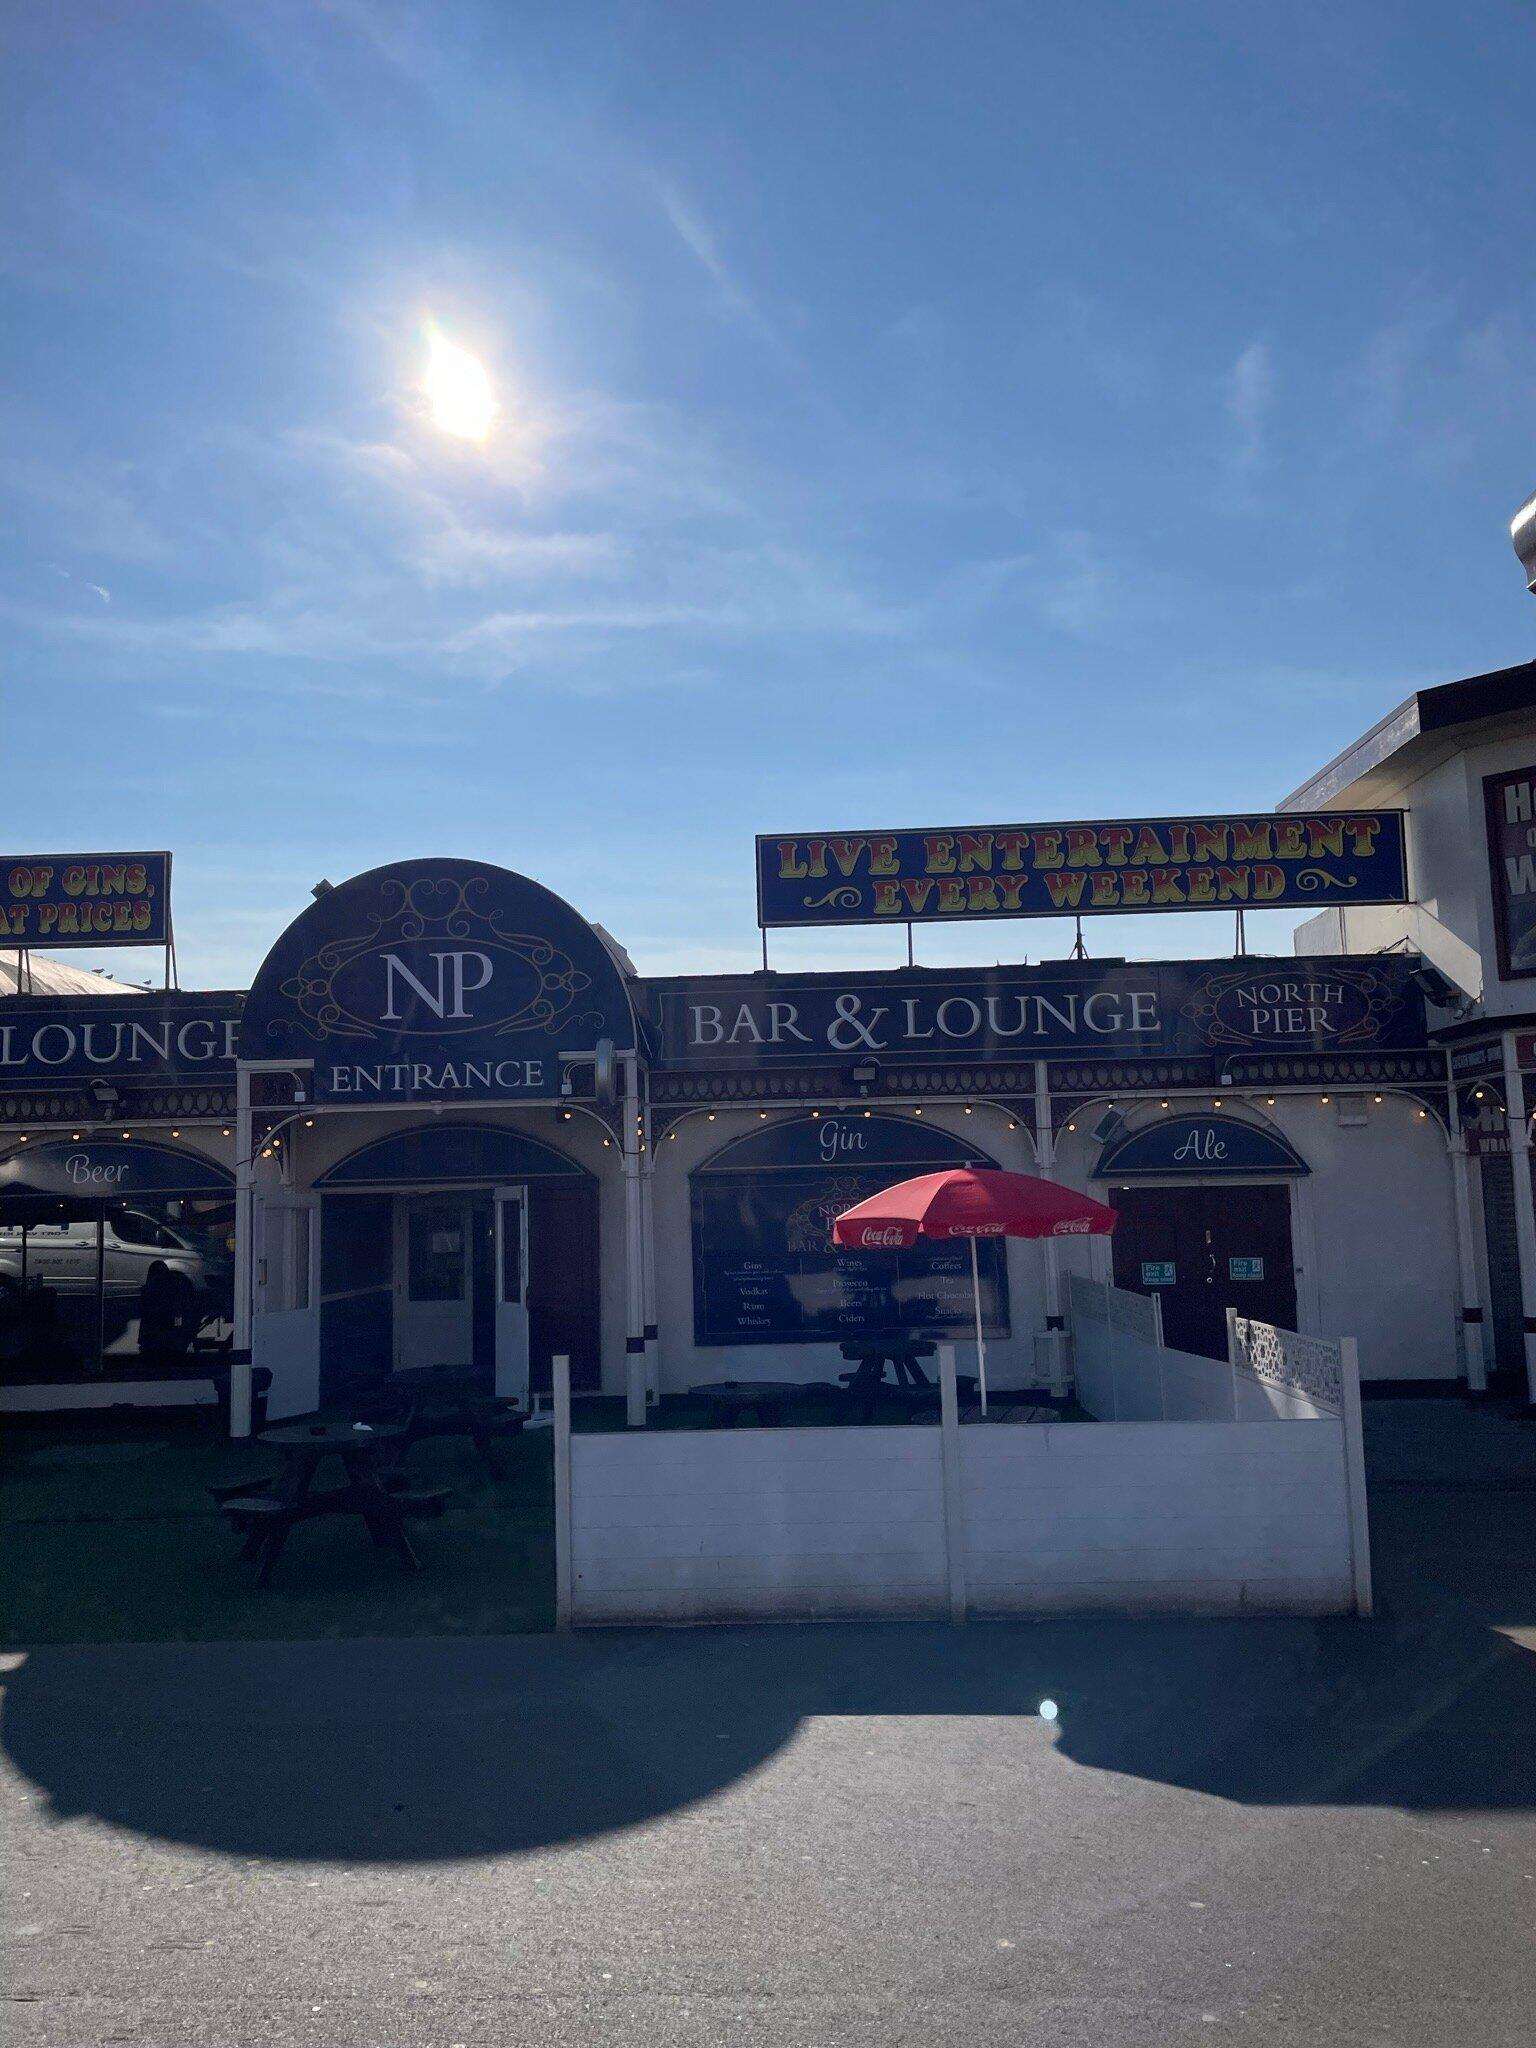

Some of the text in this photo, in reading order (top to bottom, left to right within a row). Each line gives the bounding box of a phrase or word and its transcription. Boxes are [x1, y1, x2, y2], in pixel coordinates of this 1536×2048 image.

[777, 817, 1381, 881] LIVE ENTERTAINMENT
[8, 866, 54, 897] OF
[872, 863, 1287, 915] EVERY WEEKEND
[38, 900, 151, 933] PRICES
[378, 951, 495, 1020] NP
[1235, 982, 1345, 1009] NORTH
[688, 992, 1163, 1050] BAR & LOUNGE
[1249, 1007, 1338, 1035] PIER
[329, 1061, 544, 1093] ENTRANCE
[819, 1120, 868, 1163] Gin
[1173, 1128, 1229, 1161] Ale
[65, 1154, 130, 1184] Beer
[743, 1261, 762, 1270] Gins
[836, 1258, 863, 1267] Wines
[931, 1261, 962, 1270] Coffees
[739, 1287, 769, 1296] Vodkas
[743, 1302, 765, 1310] Rum
[838, 1314, 865, 1323] Ciders
